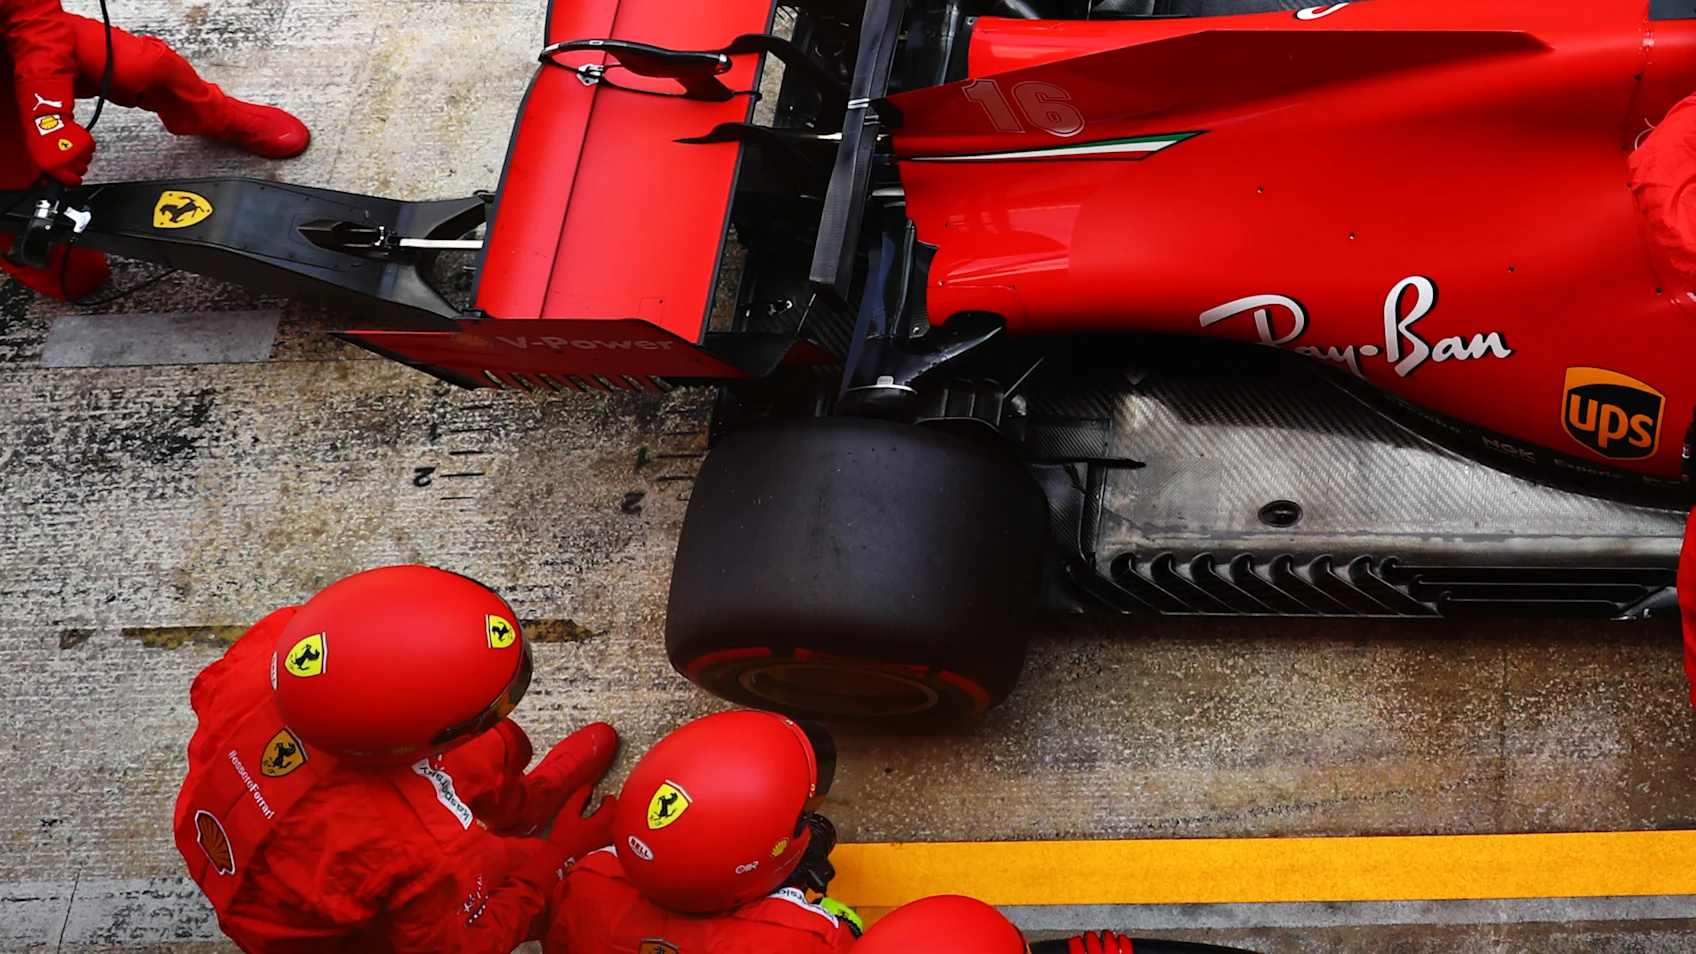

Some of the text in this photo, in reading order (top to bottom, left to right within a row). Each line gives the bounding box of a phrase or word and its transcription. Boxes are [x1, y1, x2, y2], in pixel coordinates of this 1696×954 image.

[961, 78, 1085, 137] 16
[496, 335, 674, 351] V-Power
[1199, 275, 1513, 380] Ray-Ban
[1482, 435, 1536, 461] NGK
[1569, 393, 1655, 448] ups
[411, 466, 436, 488] 2
[228, 750, 276, 821] #essereFerrari
[419, 763, 472, 823] kaspersky
[629, 836, 651, 859] BELL
